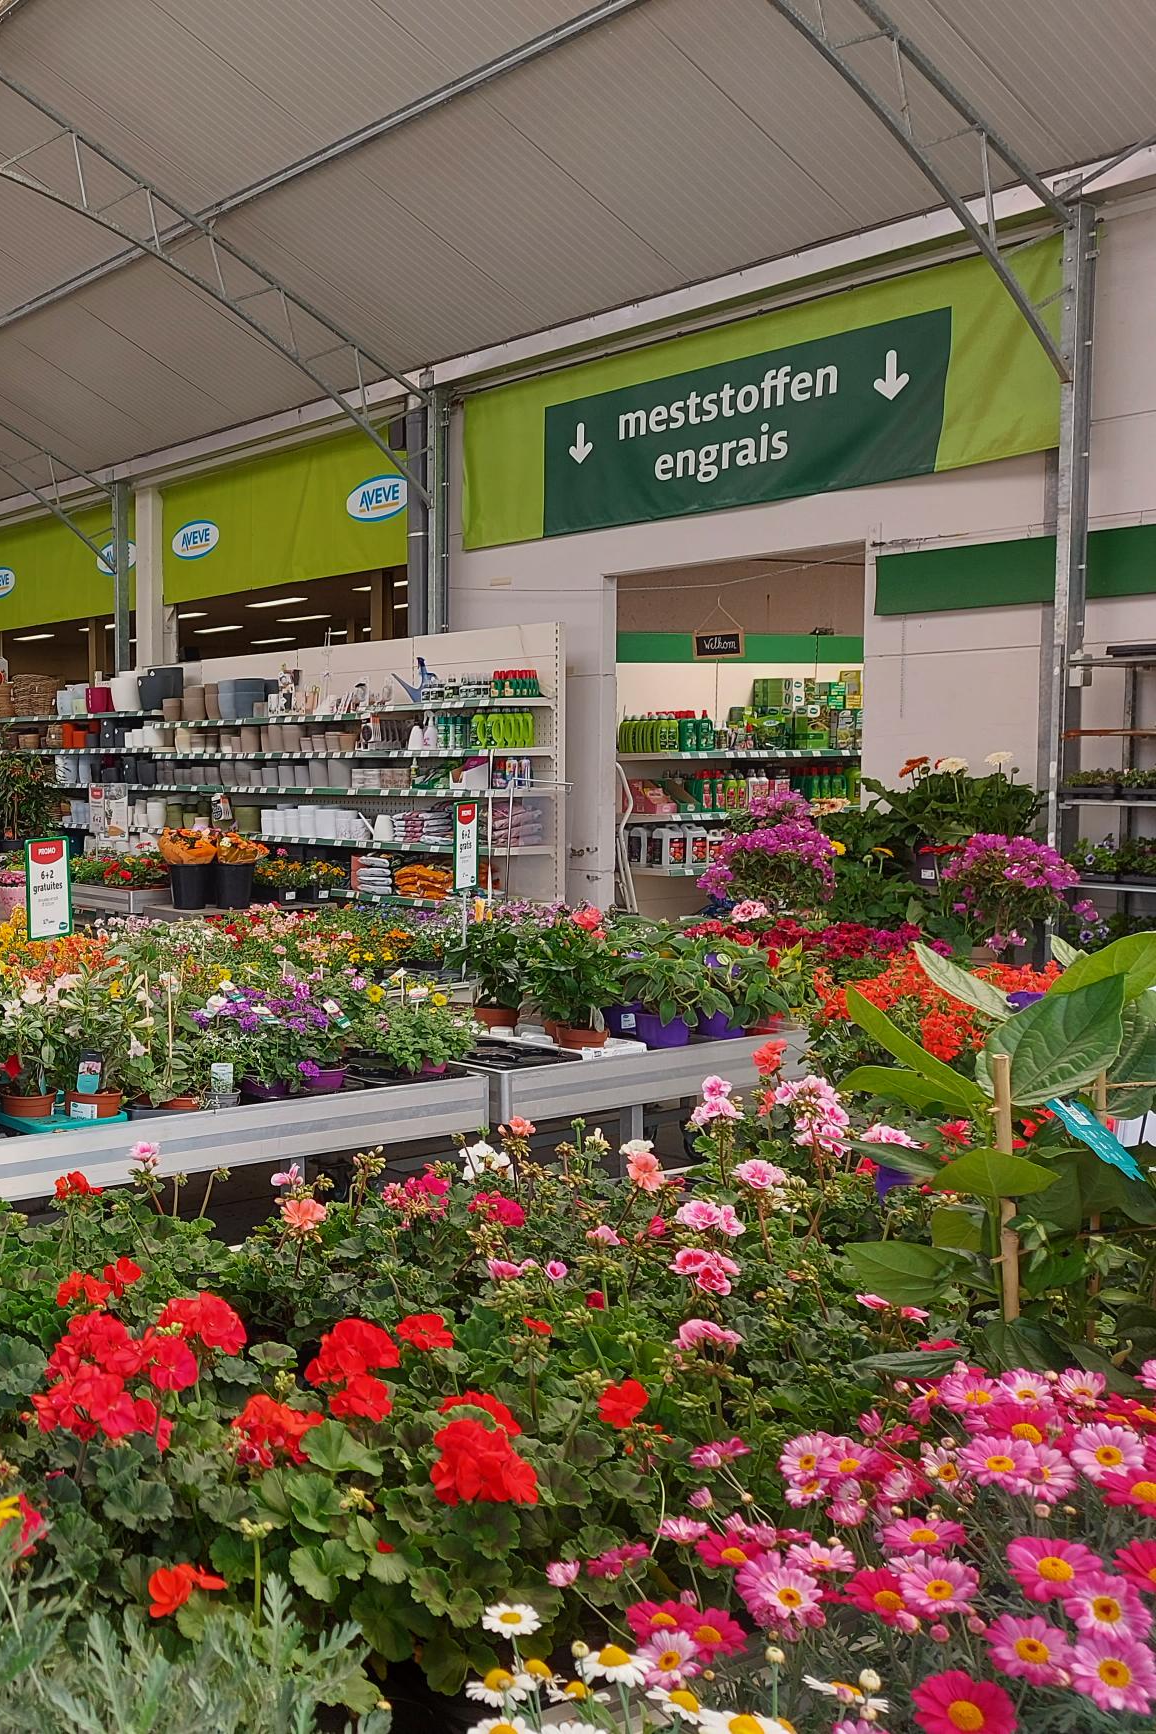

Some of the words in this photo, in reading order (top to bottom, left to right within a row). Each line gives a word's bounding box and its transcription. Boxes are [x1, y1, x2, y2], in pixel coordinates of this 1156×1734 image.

[618, 365, 838, 440] meststoffen
[654, 424, 790, 483] engrais
[359, 483, 400, 511] AVEVE
[182, 528, 210, 551] AVEVE
[37, 847, 56, 856] PROMO
[459, 843, 473, 853] gratis
[40, 870, 54, 880] 6+2
[33, 882, 63, 894] gratuites
